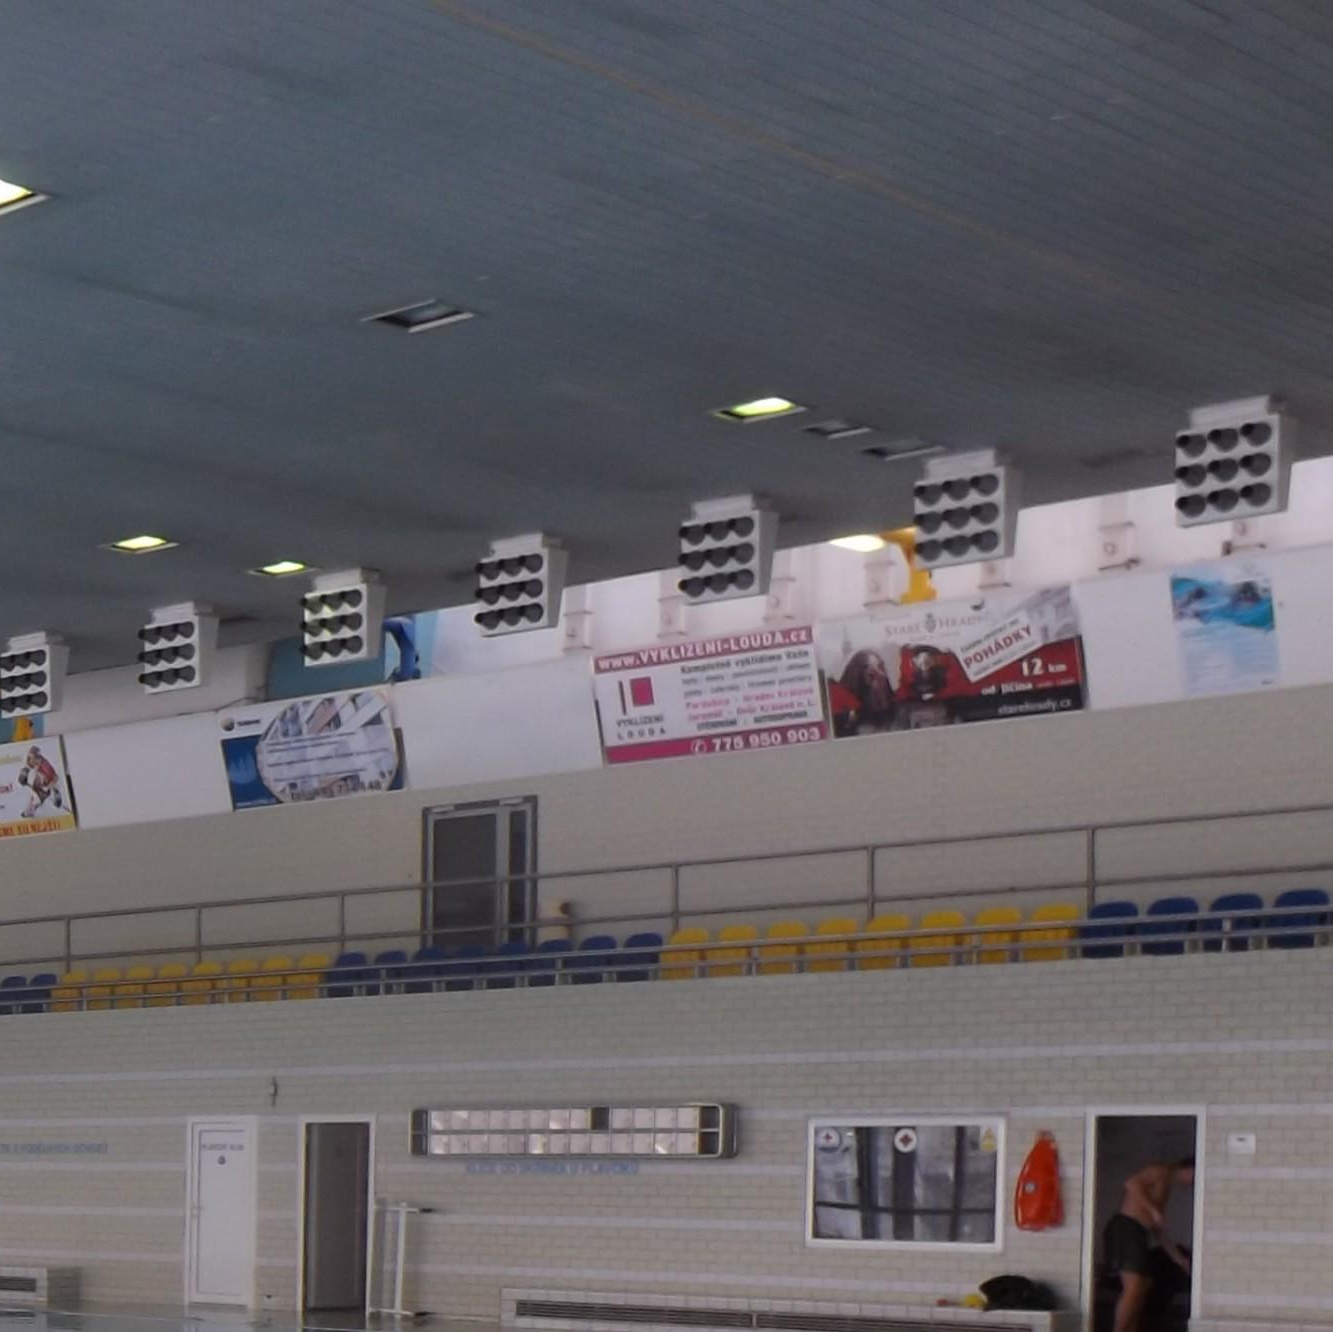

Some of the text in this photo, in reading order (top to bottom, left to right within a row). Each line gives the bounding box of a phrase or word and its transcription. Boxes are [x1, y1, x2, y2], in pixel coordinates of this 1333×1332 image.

[964, 624, 1031, 669] POHÁDKY
[1021, 657, 1067, 677] 12 km
[981, 685, 996, 696] od
[749, 732, 781, 747] 950
[787, 727, 821, 742] 903
